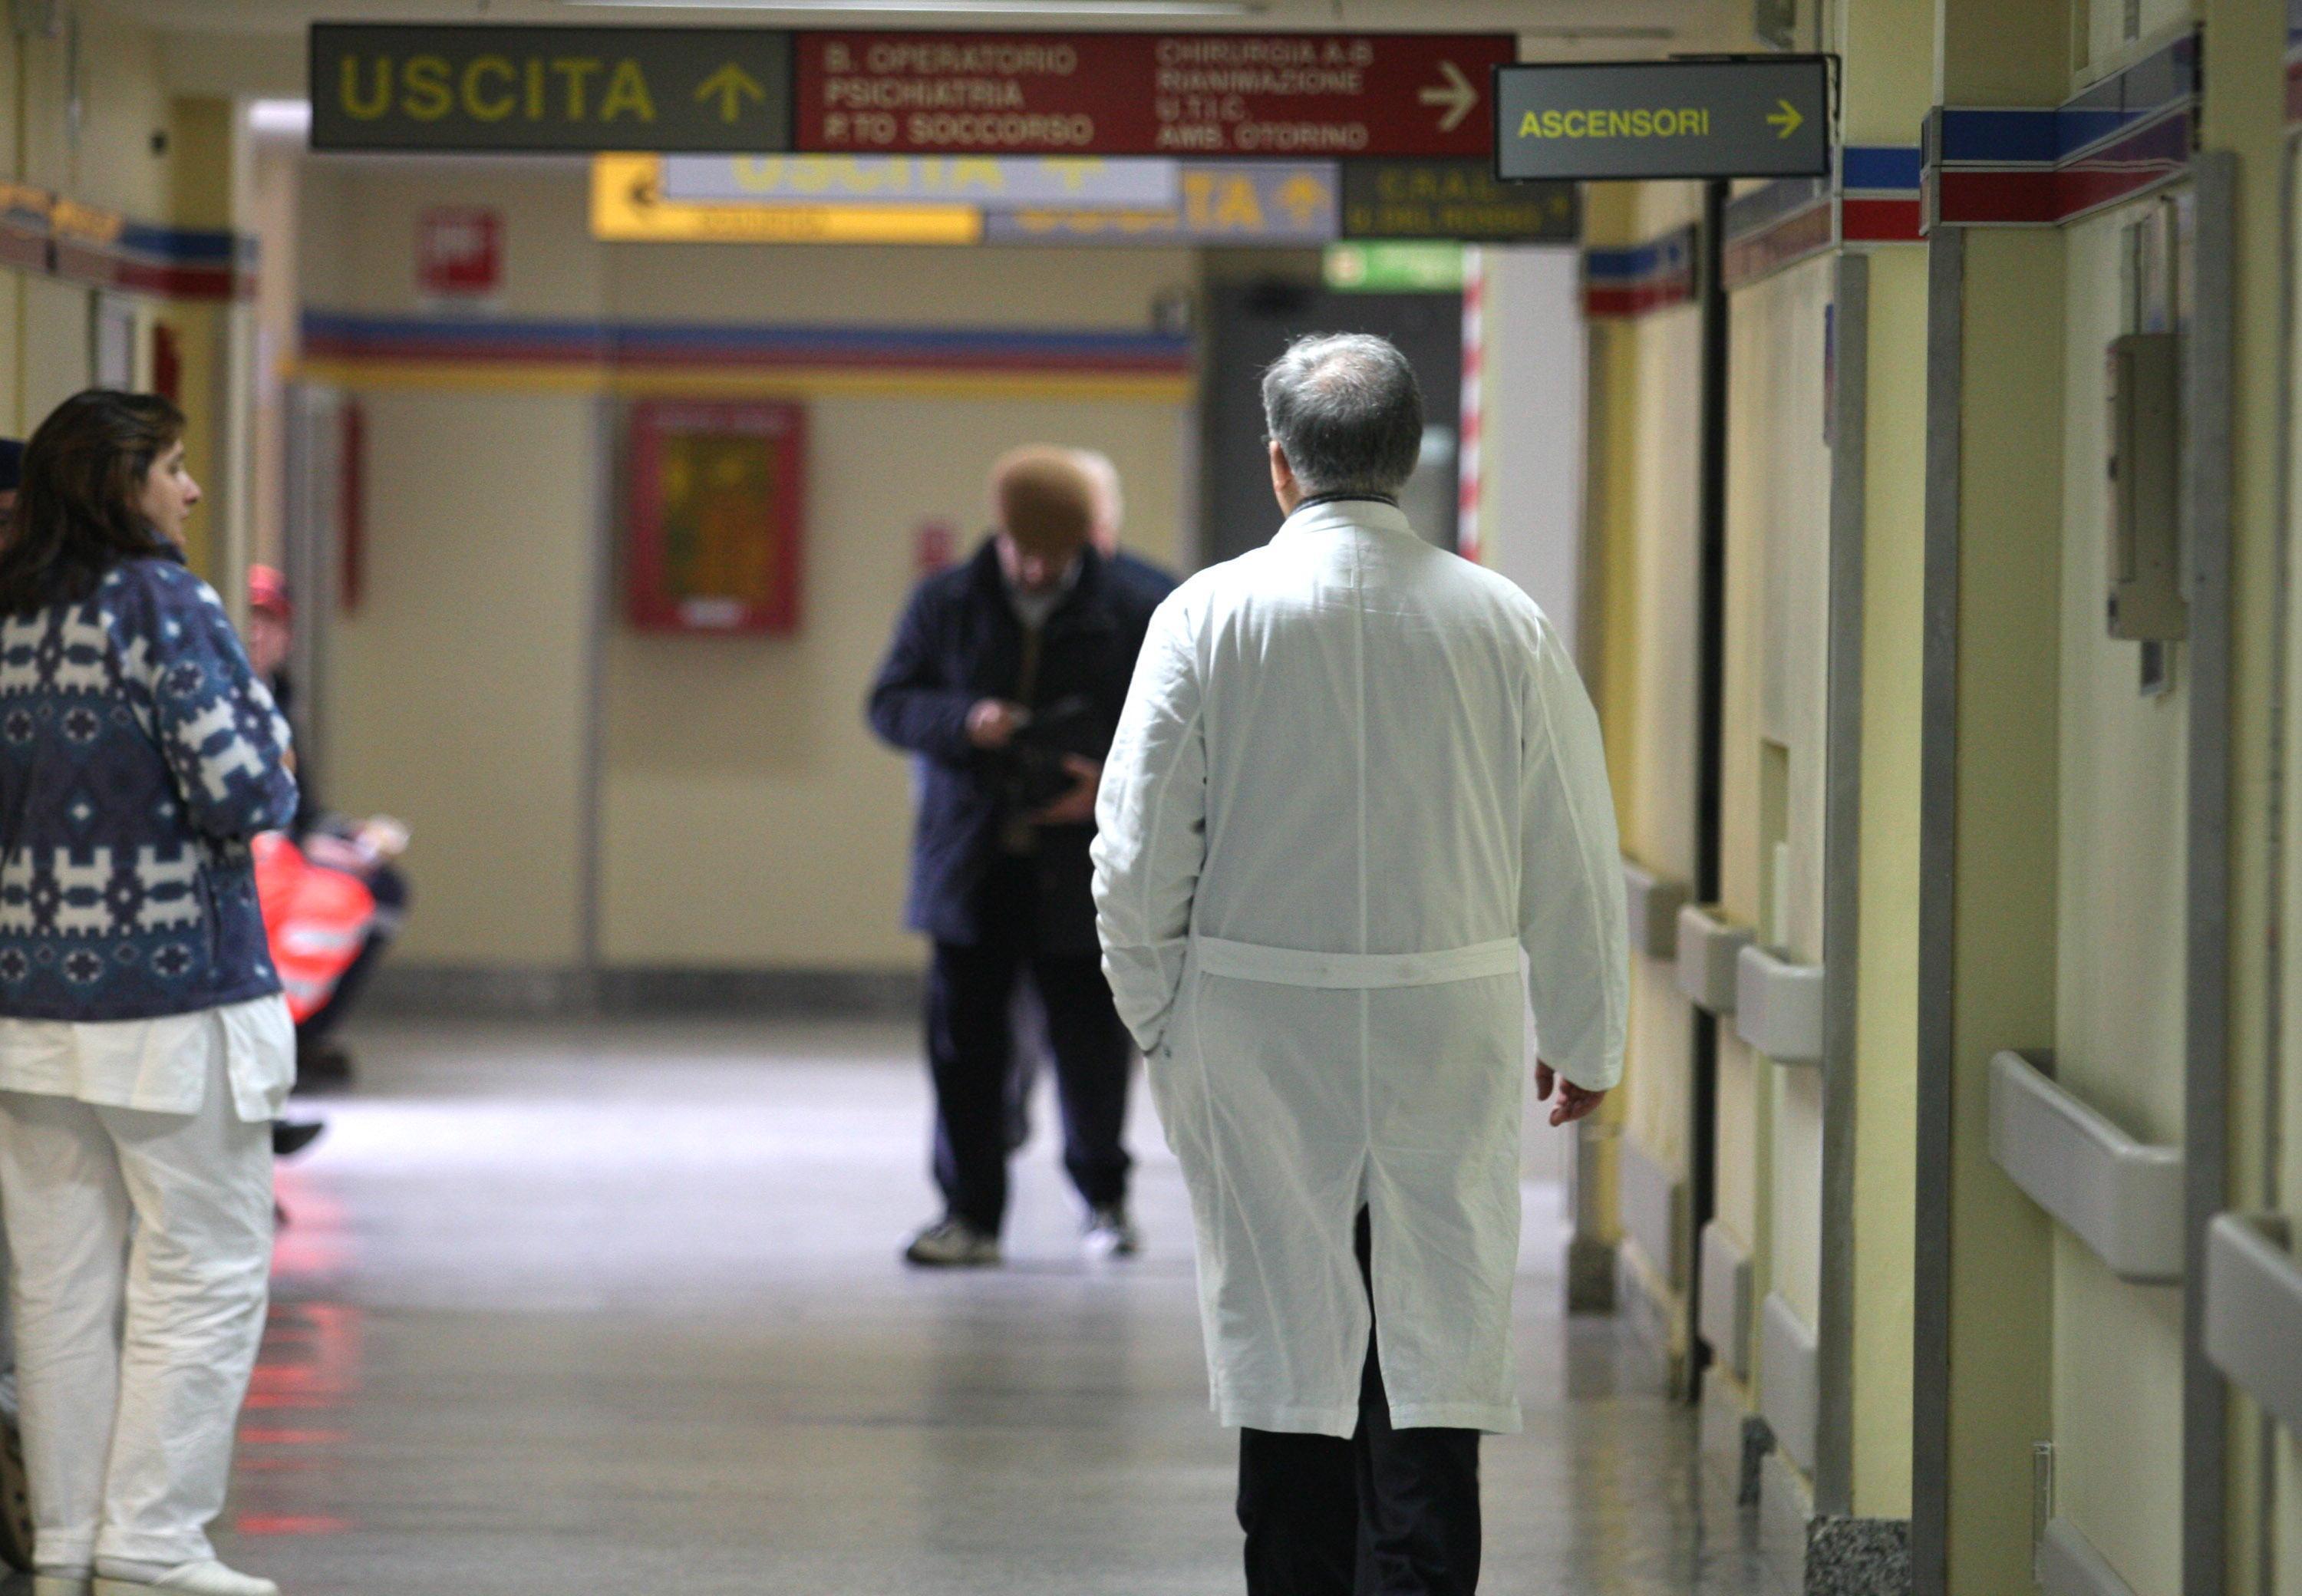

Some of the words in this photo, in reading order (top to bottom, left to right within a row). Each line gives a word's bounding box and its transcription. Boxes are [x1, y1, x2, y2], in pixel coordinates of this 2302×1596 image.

[867, 43, 1077, 74] OPERATORIO
[1155, 39, 1317, 66] CHIRURGIA
[338, 54, 655, 122] USCITA
[823, 78, 1026, 108] PSICHIATRIA
[1156, 68, 1365, 94] RIANIMAZIONE
[907, 114, 1095, 146] SOCCORSO
[1234, 124, 1370, 150] OTORINO
[1518, 108, 1710, 139] ASCENSORI
